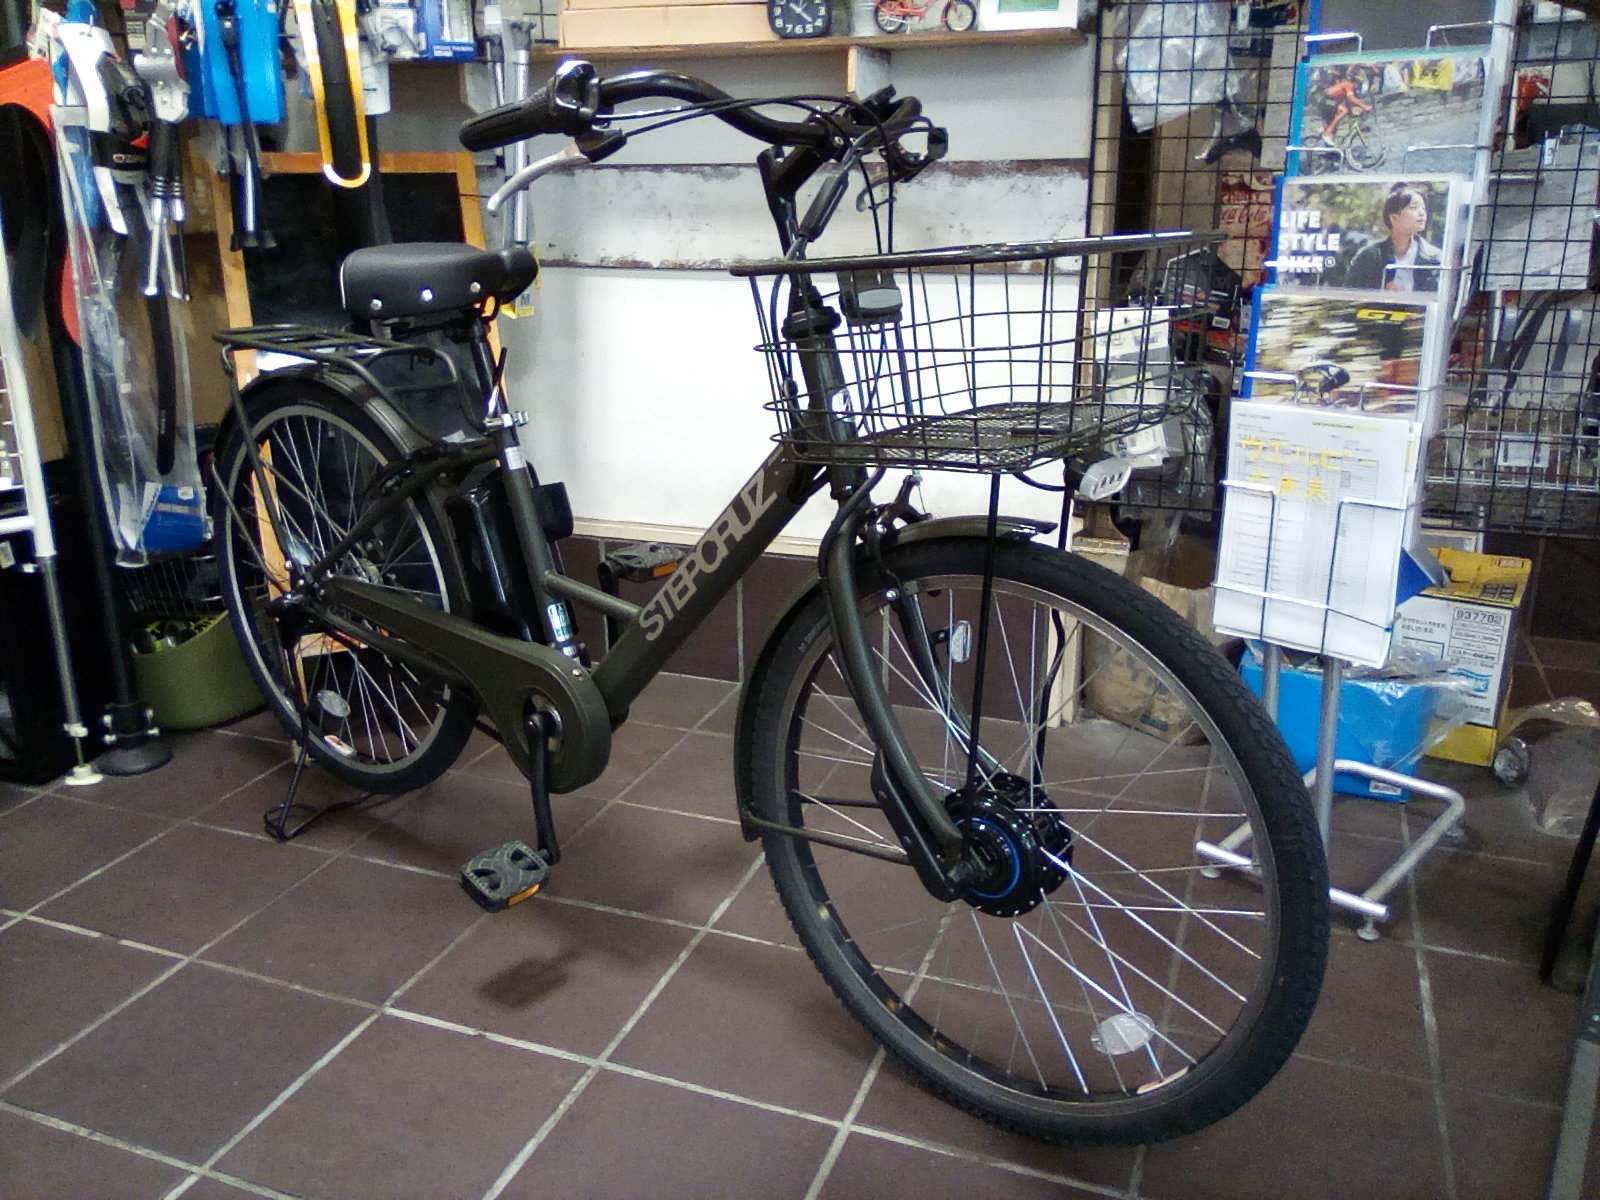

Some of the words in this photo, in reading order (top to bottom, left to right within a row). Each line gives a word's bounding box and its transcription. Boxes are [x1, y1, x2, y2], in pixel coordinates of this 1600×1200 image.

[775, 18, 783, 28] 8
[805, 23, 814, 33] 5
[814, 19, 823, 28] 4
[785, 24, 793, 33] 7
[794, 24, 803, 34] 6
[1280, 210, 1321, 229] LIFE
[1278, 232, 1341, 251] STYLE
[639, 471, 777, 641] STEPCRUZ
